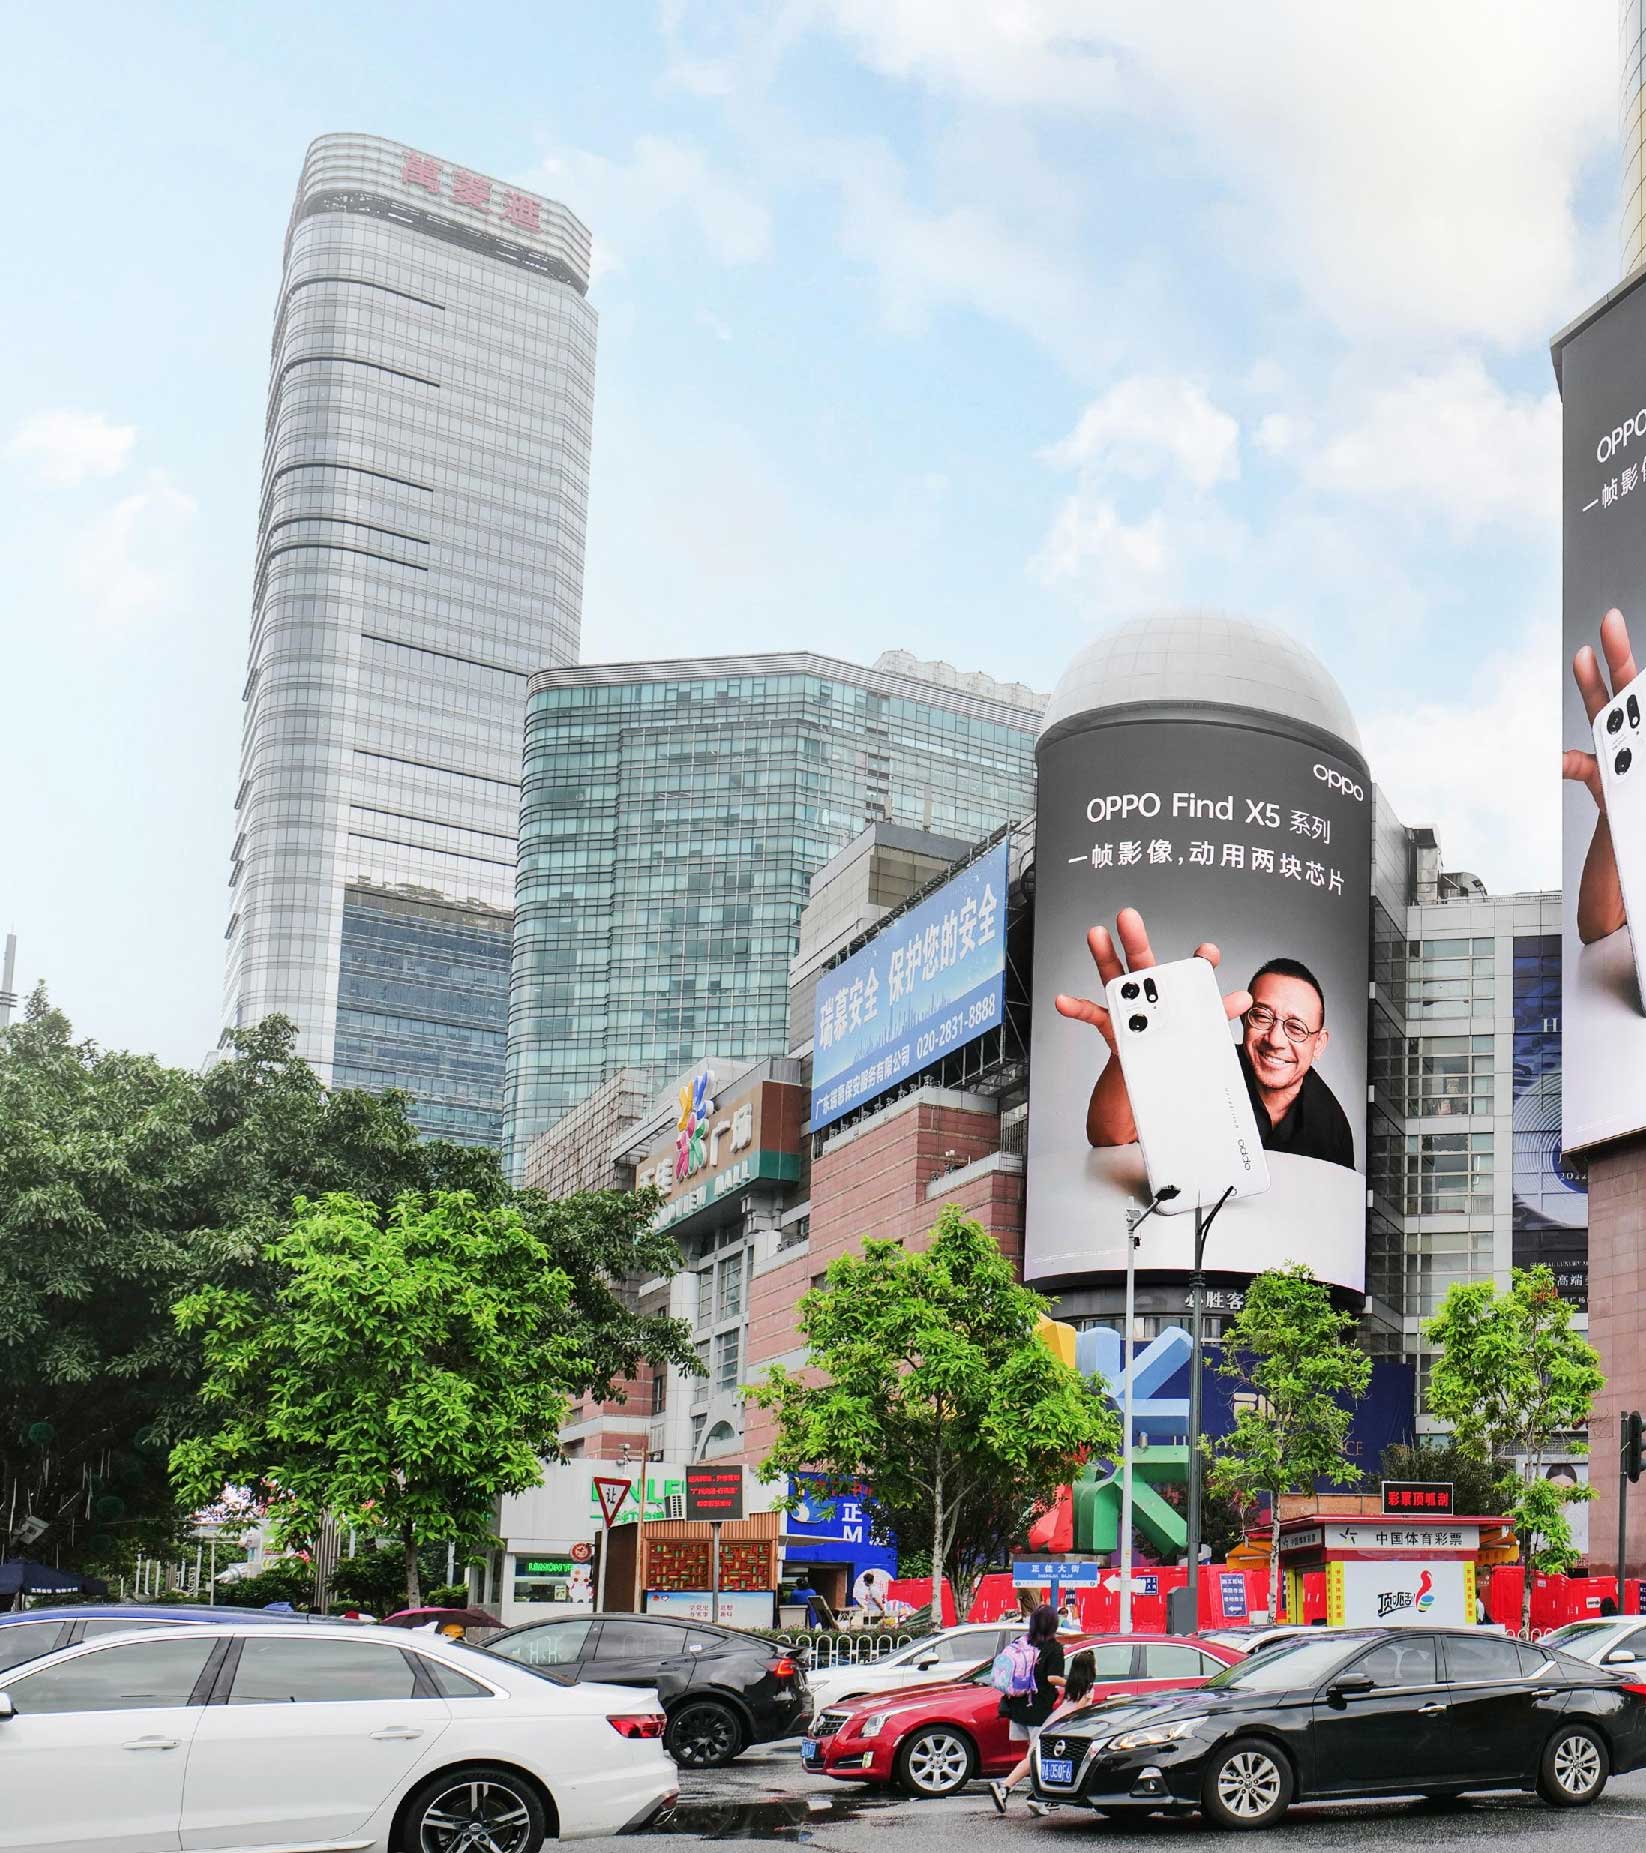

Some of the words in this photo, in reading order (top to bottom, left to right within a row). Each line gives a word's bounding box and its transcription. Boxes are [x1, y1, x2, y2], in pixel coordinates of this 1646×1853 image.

[1313, 763, 1364, 802] oppo
[1087, 792, 1161, 822] OPPO
[1172, 792, 1234, 821] Find
[1245, 798, 1281, 828] X5
[1289, 809, 1331, 844] 系列
[888, 883, 997, 1007] 保护您的安全
[1376, 1530, 1463, 1546] 中国体育彩票
